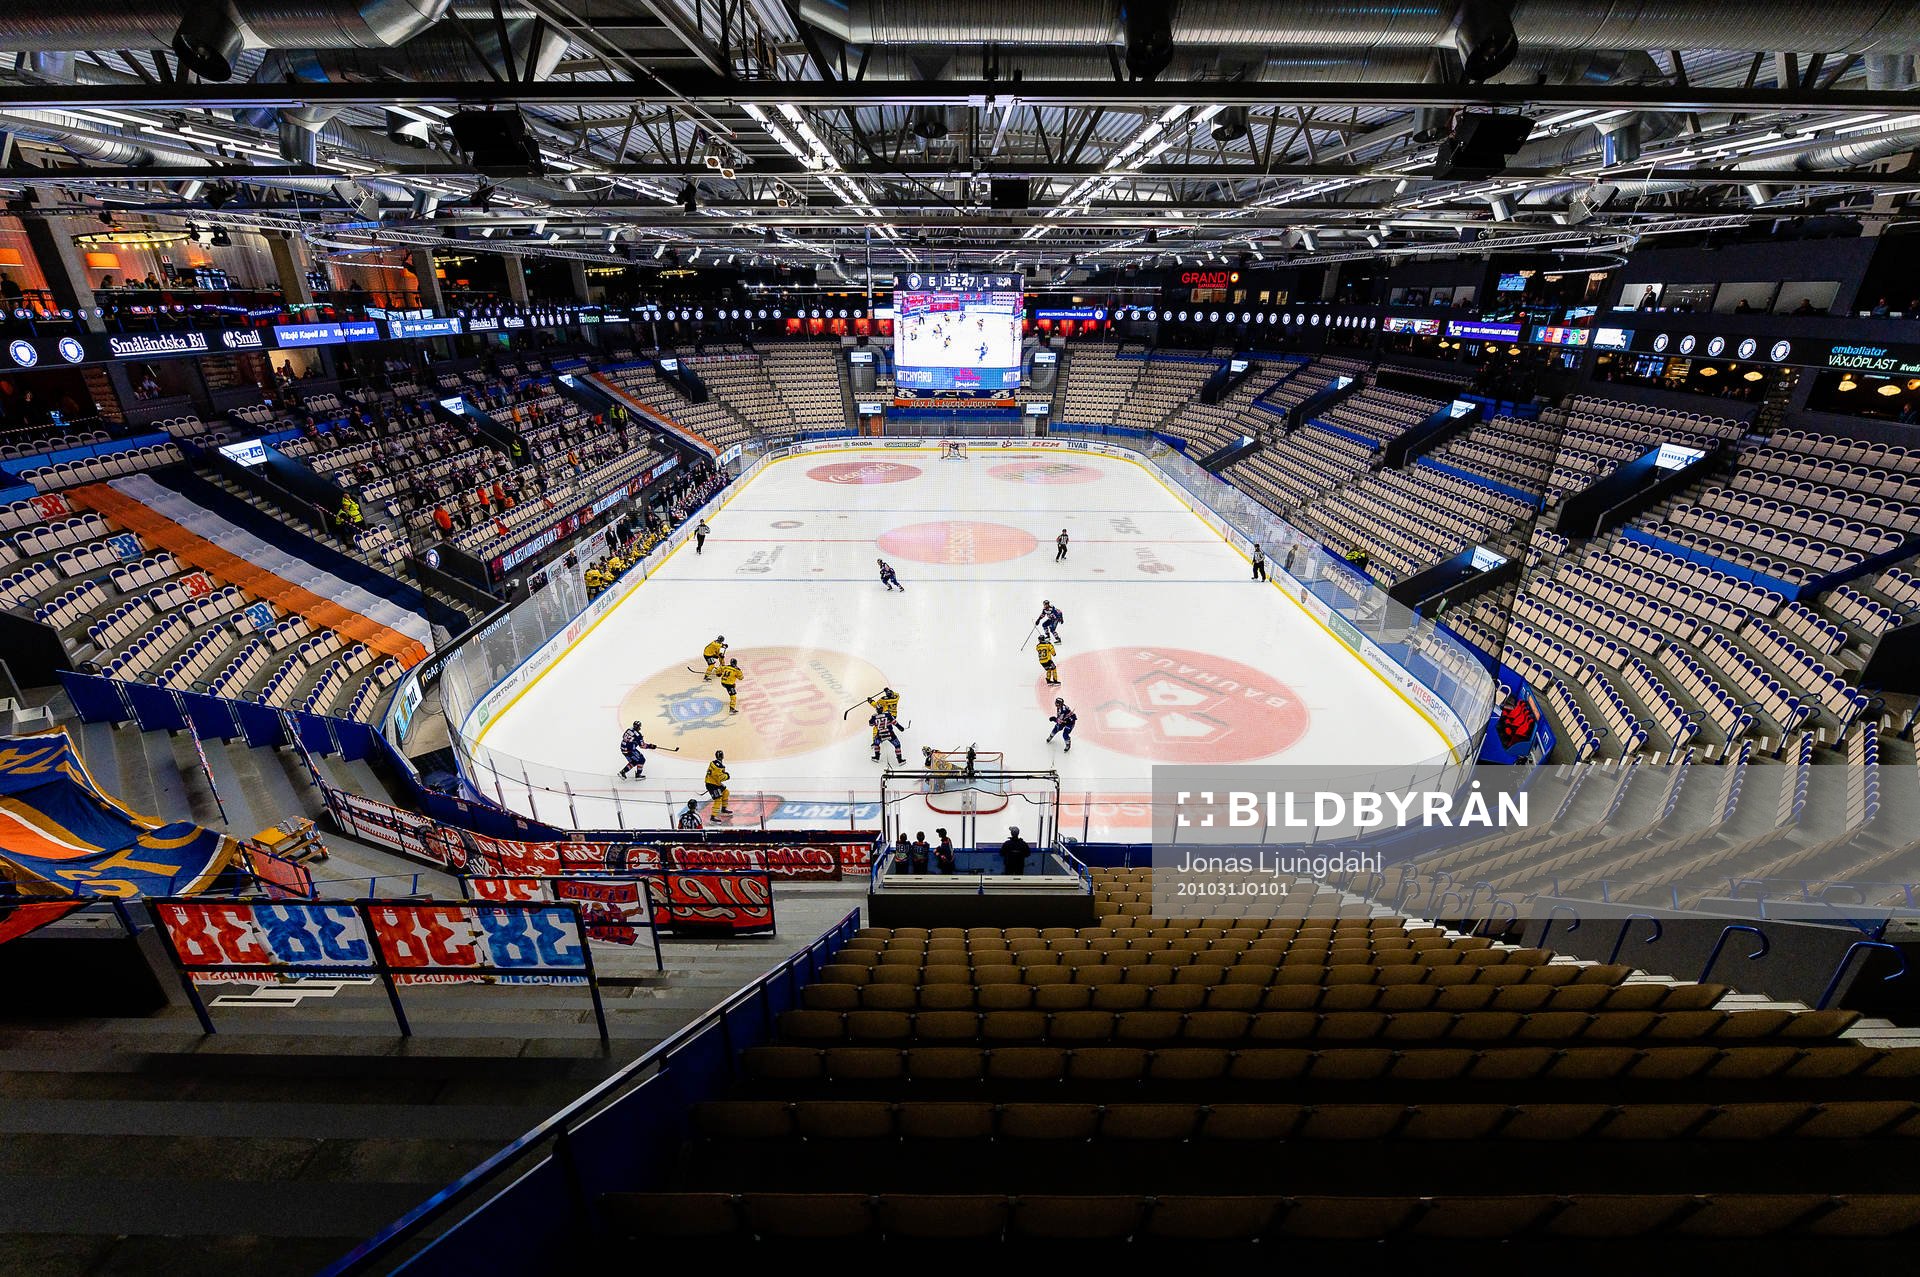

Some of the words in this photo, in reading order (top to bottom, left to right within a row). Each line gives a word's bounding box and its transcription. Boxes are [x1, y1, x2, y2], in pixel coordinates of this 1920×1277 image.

[983, 276, 990, 287] 1
[1181, 271, 1227, 284] GRAND
[110, 334, 187, 353] Småländska
[187, 331, 207, 348] Bil
[235, 329, 262, 345] Smål
[1827, 353, 1898, 370] VÄXJÖPLAST
[1831, 345, 1888, 356] emballator
[1067, 441, 1088, 449] TIVAB
[33, 494, 66, 518] 38
[112, 534, 142, 558] 38
[181, 573, 211, 598] 38
[245, 602, 277, 629] 38
[478, 612, 511, 641] GARANTUM
[425, 646, 464, 681] GARANTUM
[1136, 651, 1290, 708] BAUHAUS
[486, 676, 519, 708] FORTNOX
[1411, 683, 1450, 723] INTERSPORT
[876, 717, 888, 730] 27
